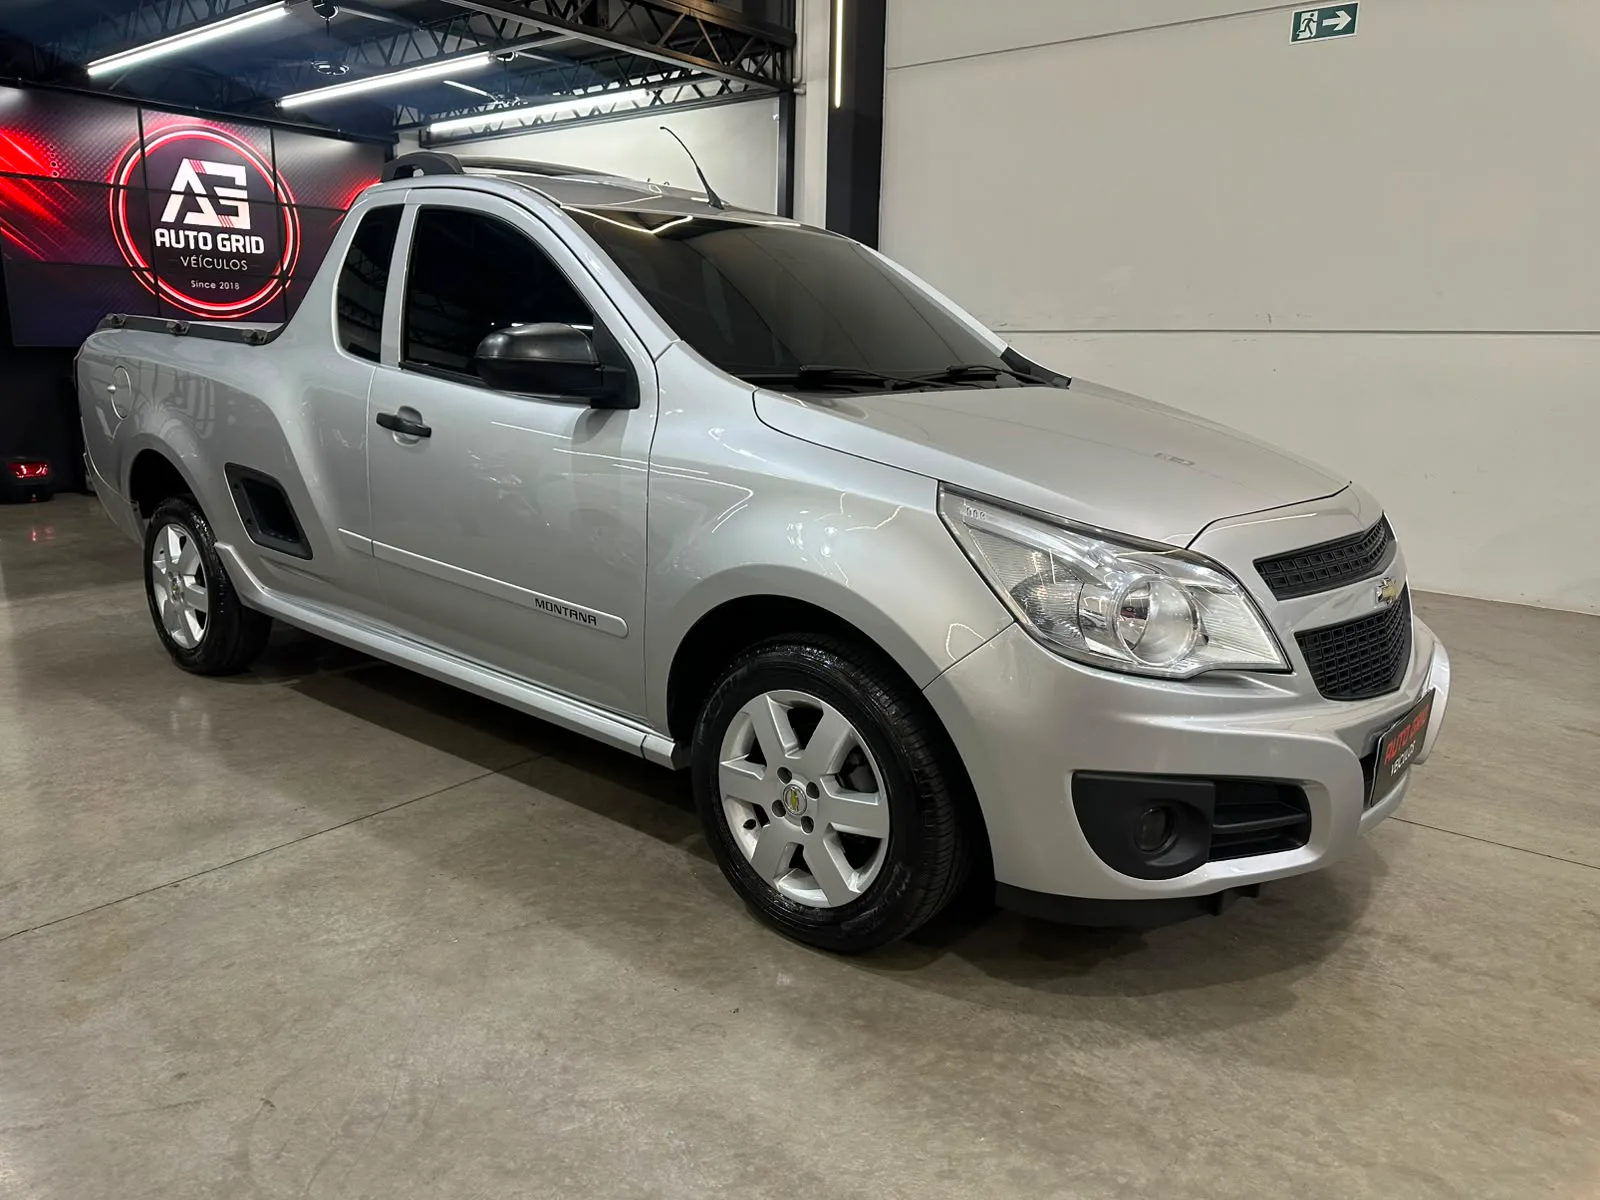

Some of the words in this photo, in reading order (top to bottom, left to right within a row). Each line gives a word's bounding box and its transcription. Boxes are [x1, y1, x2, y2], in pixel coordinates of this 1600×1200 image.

[155, 228, 213, 250] AUTO
[216, 233, 265, 254] GRID
[190, 280, 216, 289] Since
[219, 281, 240, 290] 2018
[535, 599, 597, 626] MONTANA
